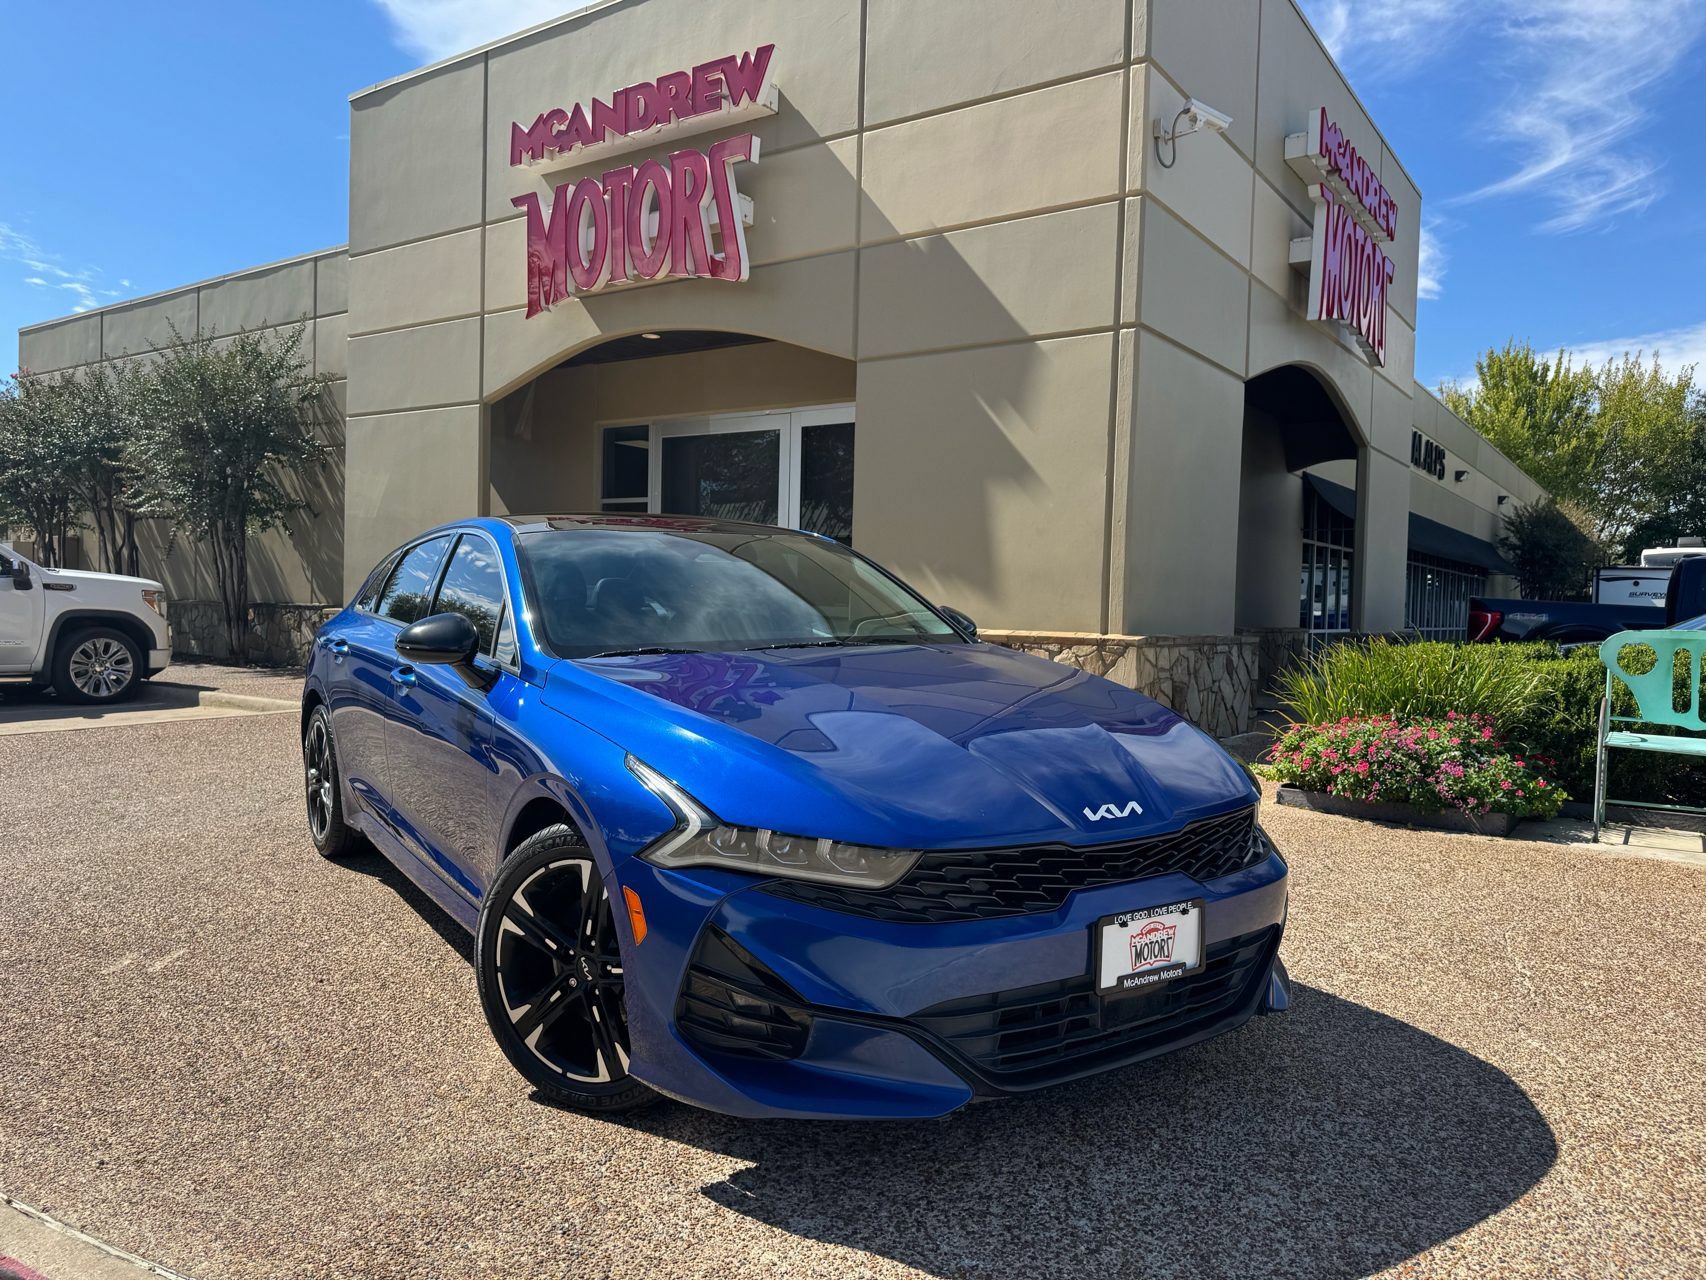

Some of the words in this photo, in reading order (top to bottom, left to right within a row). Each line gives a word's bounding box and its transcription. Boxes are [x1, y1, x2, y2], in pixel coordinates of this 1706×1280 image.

[510, 133, 753, 320] MOTORS
[1318, 182, 1395, 368] MOTORS
[1083, 801, 1143, 821] KIA
[1114, 914, 1133, 924] LOVE
[1133, 911, 1150, 920] GOD.
[1150, 906, 1168, 917] LOVE
[1132, 937, 1172, 967] MOTORS
[1123, 974, 1160, 988] McAndrew
